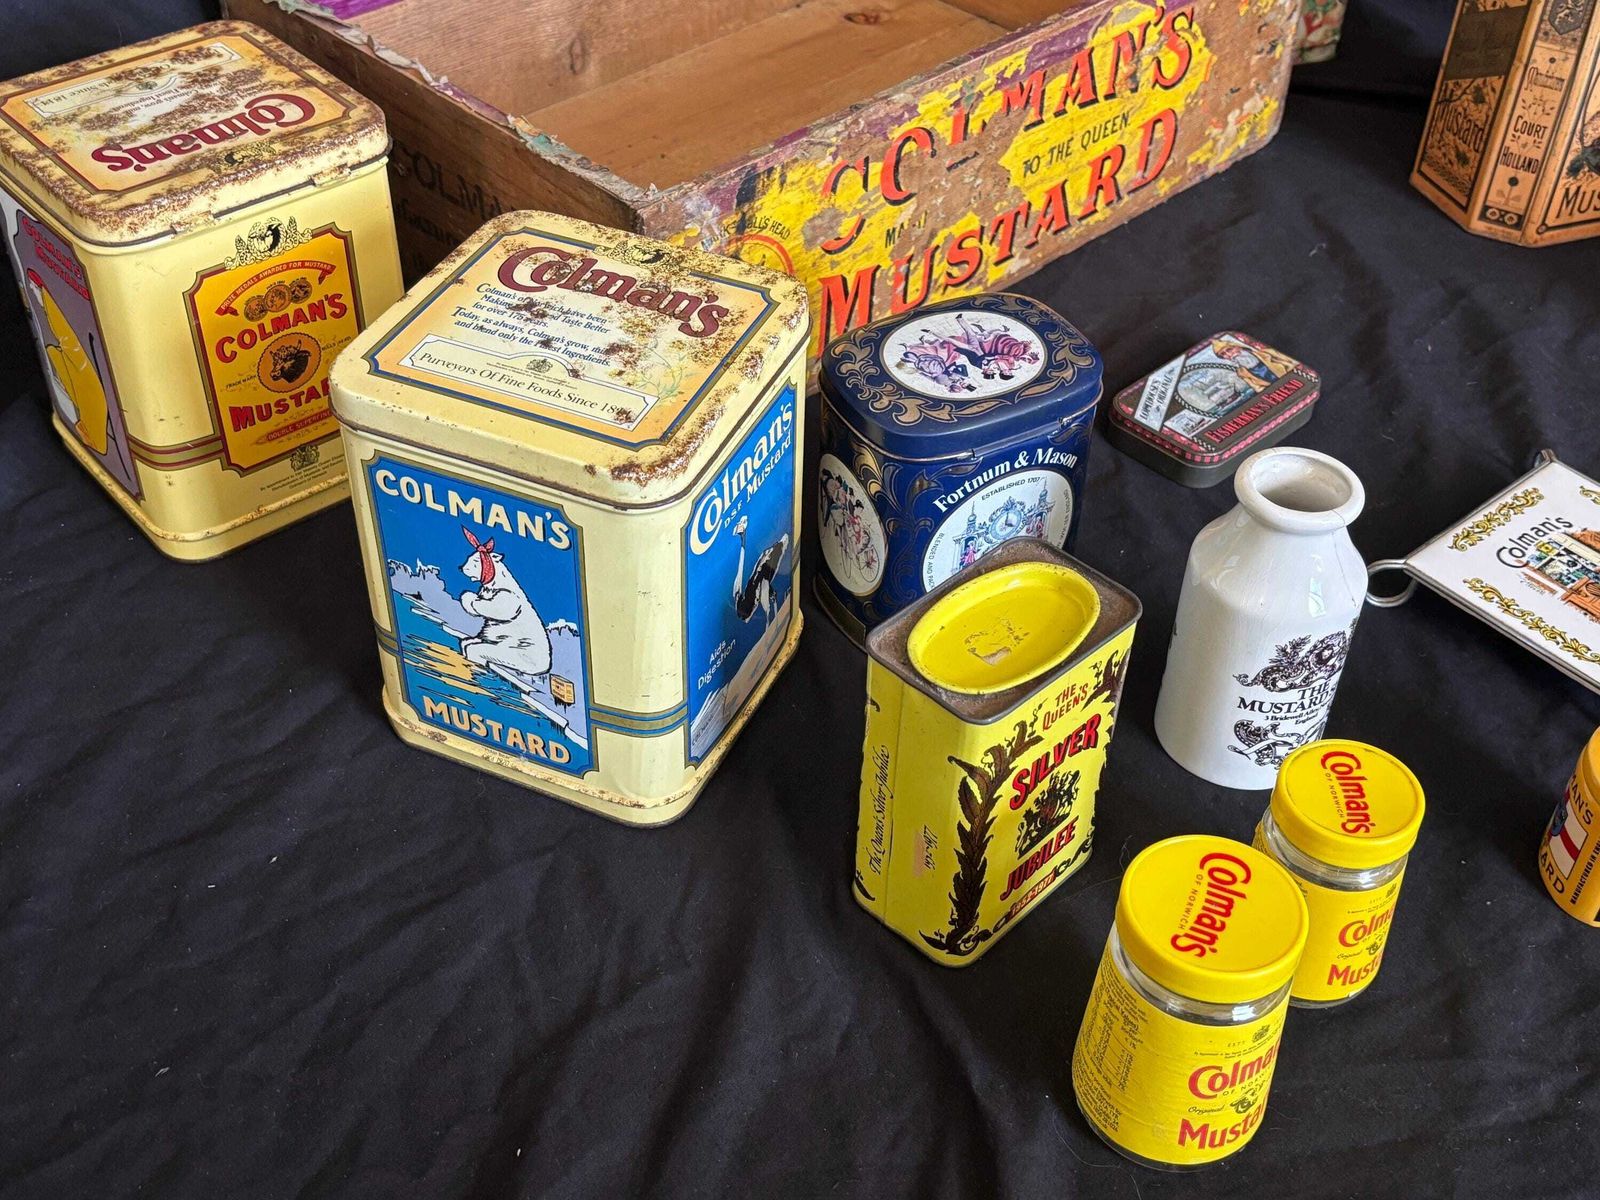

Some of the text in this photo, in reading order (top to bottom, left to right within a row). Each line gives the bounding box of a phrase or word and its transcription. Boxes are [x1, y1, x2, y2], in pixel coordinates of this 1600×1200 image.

[92, 94, 315, 172] Colman's
[1513, 115, 1549, 138] COURT
[1022, 155, 1042, 179] TO
[1048, 141, 1076, 165] THE
[1499, 146, 1541, 175] HOLLAND
[768, 219, 791, 240] HEAD
[817, 108, 1178, 350] MUSTARD
[221, 293, 236, 310] PRIZE
[237, 277, 258, 295] MEDALS
[259, 264, 287, 280] AWARDED
[288, 261, 302, 270] FOR
[304, 261, 332, 271] MUSTARD
[472, 301, 486, 311] for
[487, 307, 508, 316] over
[508, 312, 525, 321] 175
[476, 282, 517, 300] Colman's
[565, 307, 587, 319] have
[586, 313, 608, 325] been
[497, 246, 729, 339] Colman's
[215, 293, 347, 363] COLMAN'S
[452, 306, 481, 322] Today,
[482, 316, 493, 325] as
[493, 319, 525, 334] always,
[527, 327, 566, 344] Colman's
[564, 339, 590, 352] grow,
[481, 294, 512, 310] Making
[561, 315, 582, 328] Taste
[584, 321, 611, 334] Better
[455, 319, 473, 330] and
[472, 323, 499, 337] blend
[498, 329, 518, 343] only
[518, 337, 534, 347] the
[562, 346, 611, 367] Ingredients.
[229, 377, 330, 433] MUSTA
[419, 352, 478, 376] Purveyors
[479, 367, 499, 380] Of
[498, 374, 526, 389] Fine
[526, 381, 562, 399] Foods
[564, 392, 598, 409] Since
[601, 402, 633, 421] 18
[1205, 403, 1267, 444] FISHERMAN'S
[1262, 378, 1305, 410] FRIEND
[689, 400, 793, 556] Colman's
[746, 430, 791, 504] Mustard
[932, 447, 1078, 513] Fortnum & Mason
[981, 479, 1026, 501] ESTABLISHED
[375, 469, 574, 551] COLMAN'S
[929, 532, 945, 560] BLENDED
[1496, 515, 1574, 569] Colman's
[697, 638, 737, 690] Digestion
[708, 638, 728, 666] Aids
[1042, 684, 1089, 731] QUEEN'S
[1055, 684, 1077, 707] THE
[1236, 690, 1330, 714] MUSTARD
[1298, 681, 1331, 700] THE
[423, 695, 574, 765] MUSTARD
[1009, 713, 1102, 811] SILVER
[865, 744, 894, 875] The Queen's Silver Jubilee
[1320, 751, 1376, 836] Colman's
[1324, 772, 1345, 819] OF NORWICH
[1000, 815, 1080, 901] JUBILEE
[1569, 860, 1594, 905] MANUFACTURED
[1590, 853, 1598, 865] IN
[1170, 852, 1252, 959] Colman's
[1177, 873, 1204, 931] OF NORWICH
[1222, 1087, 1236, 1098] OF
